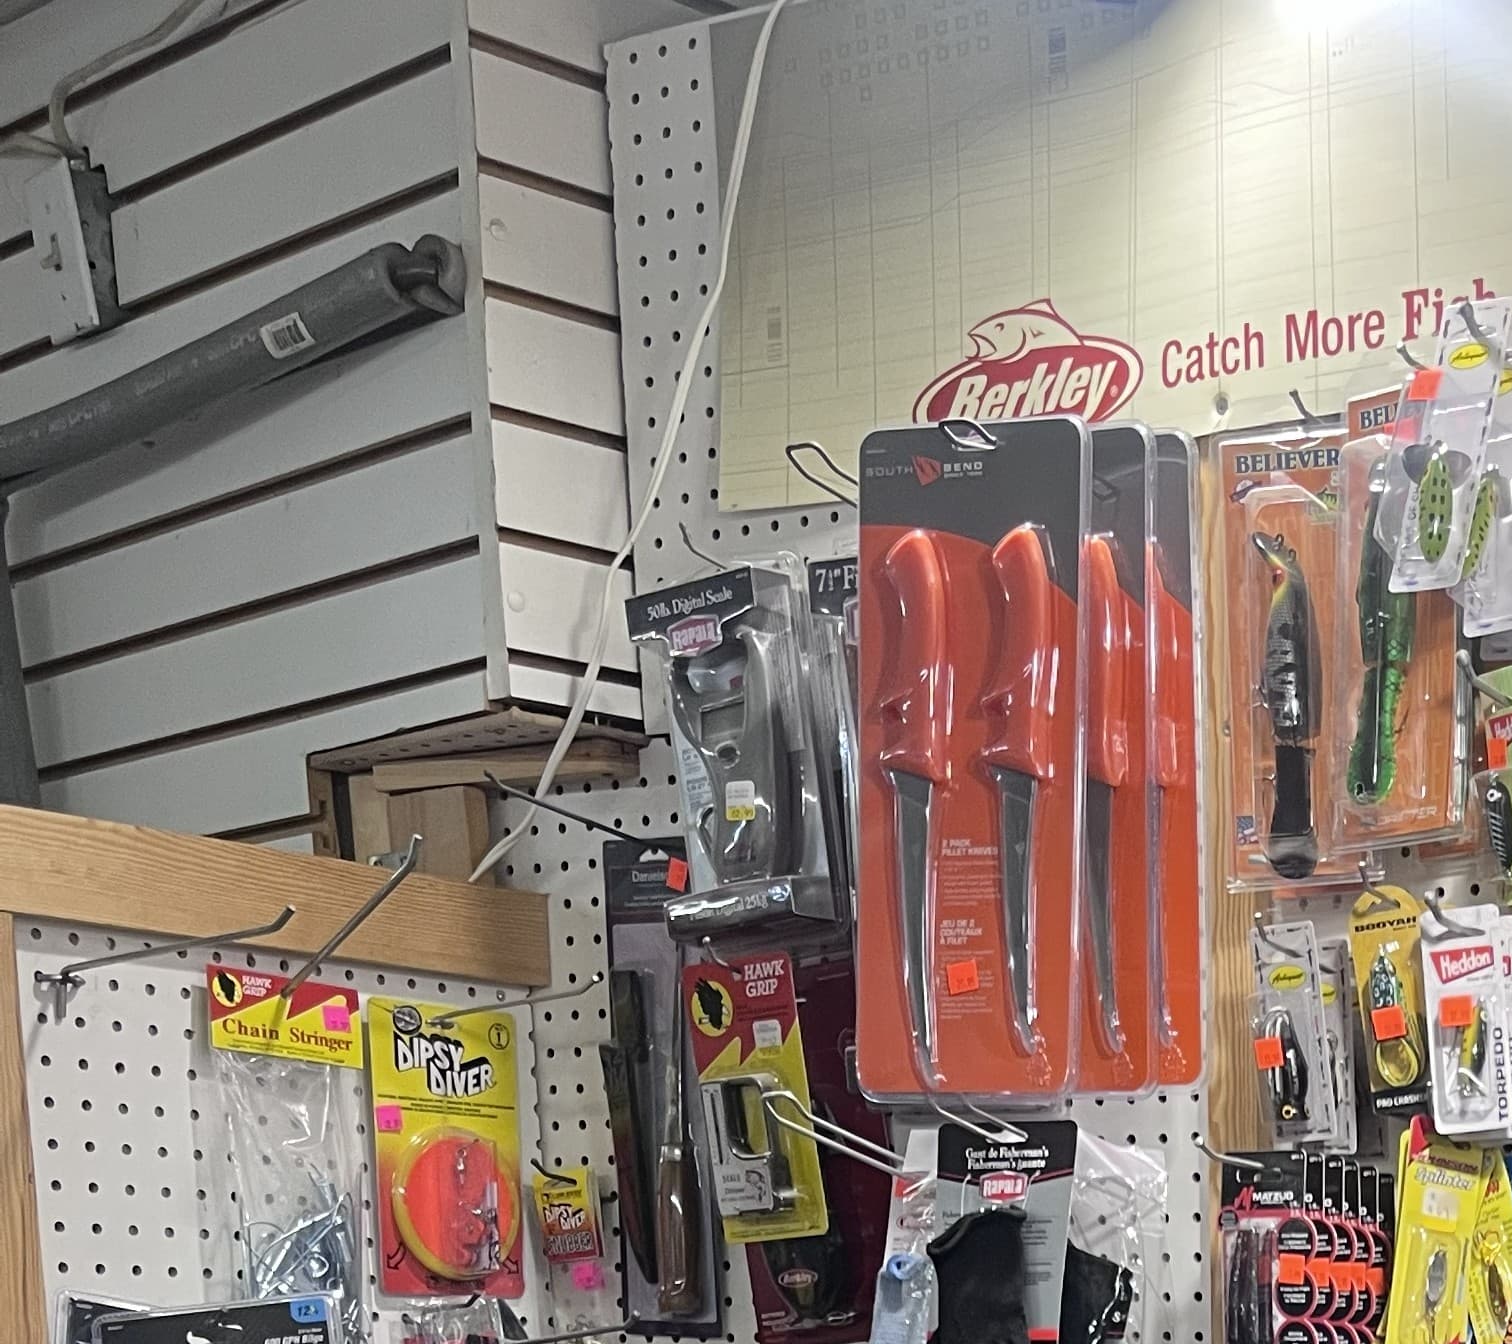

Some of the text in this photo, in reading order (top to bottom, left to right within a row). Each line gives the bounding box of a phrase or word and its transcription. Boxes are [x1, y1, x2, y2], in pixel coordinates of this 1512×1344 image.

[1161, 325, 1264, 389] Catch
[1284, 308, 1385, 364] More
[951, 350, 1112, 421] Berkley
[943, 460, 982, 473] BEND
[1234, 448, 1339, 473] BELIEVER
[1355, 915, 1418, 933] BOOYAH
[743, 960, 784, 981] HAWK
[1438, 948, 1493, 981] Heddon
[242, 975, 271, 988] HAWK
[242, 986, 267, 997] GRIP
[745, 979, 778, 997] GRIP
[222, 1019, 353, 1052] Chain Stringer
[397, 1036, 462, 1072] DIPSY
[428, 1065, 496, 1097] DIVER
[1499, 1026, 1509, 1122] TORPEDO
[1252, 1191, 1294, 1203] MATZUO
